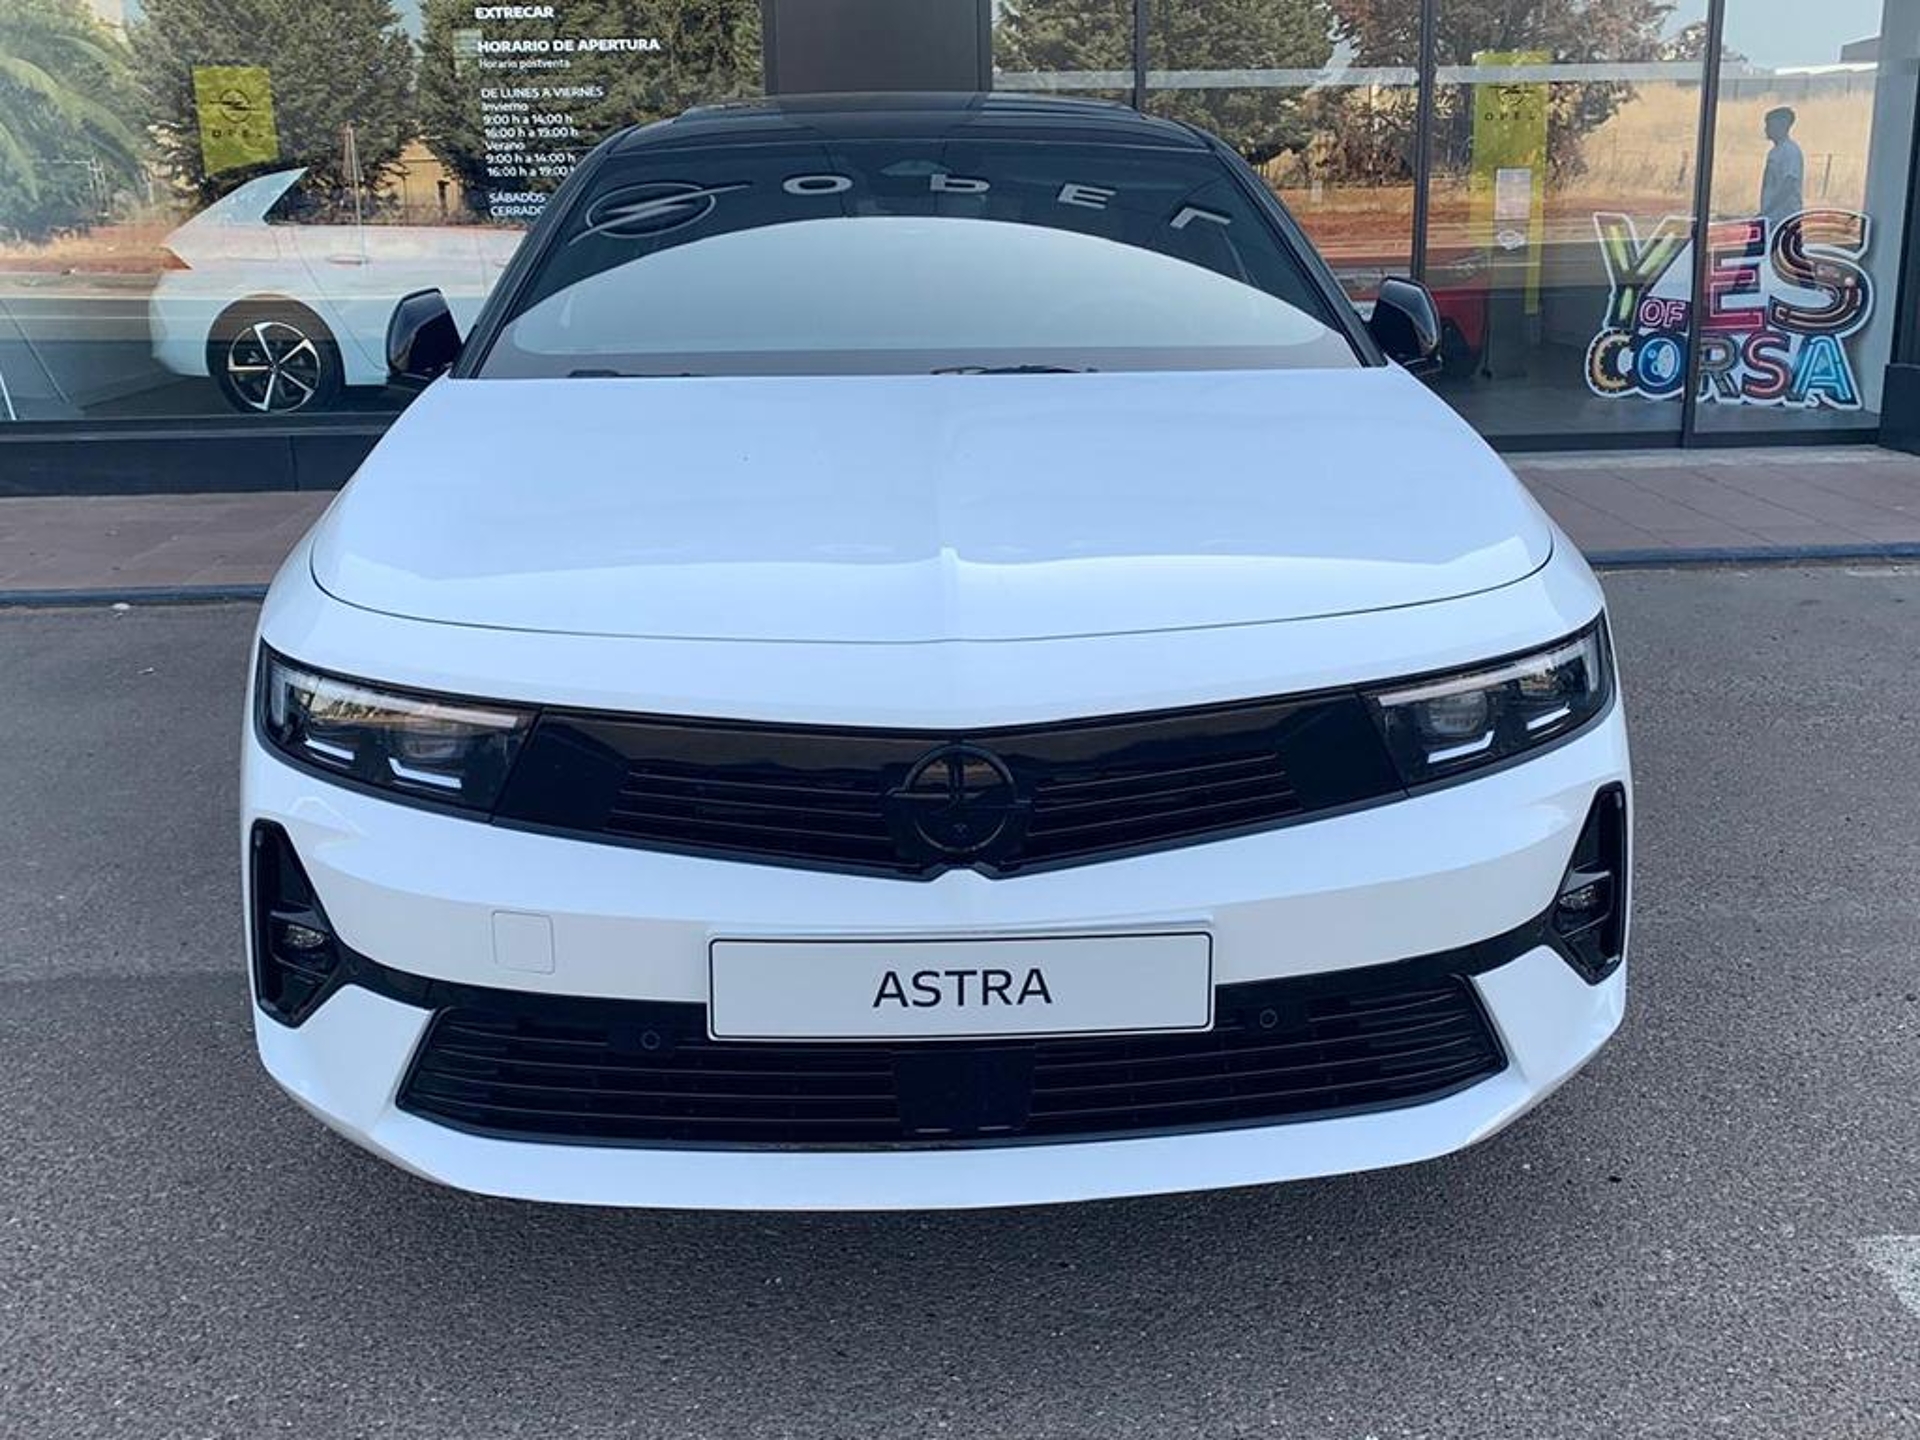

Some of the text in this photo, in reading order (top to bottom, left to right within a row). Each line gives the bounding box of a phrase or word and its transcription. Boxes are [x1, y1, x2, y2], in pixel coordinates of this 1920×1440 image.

[475, 7, 554, 20] EXTRECAR
[477, 38, 661, 53] HORARIO DE APERTURA
[479, 58, 571, 70] Horario postventa
[481, 86, 604, 98] DE LUNES A VIERNES
[482, 102, 529, 111] Invierno
[483, 113, 573, 125] 9:00 h a 14:00 h
[518, 127, 526, 137] h
[528, 129, 536, 138] a
[570, 126, 579, 137] h
[485, 141, 525, 150] Verano
[485, 152, 576, 164] 9:00 h a 14:00 h
[487, 167, 517, 177] 16:00
[519, 166, 527, 176] h
[530, 168, 537, 177] a
[1593, 209, 1874, 338] YES
[1638, 298, 1687, 330] OF
[1586, 330, 1862, 410] CORSA
[872, 967, 1053, 1009] ASTRA
